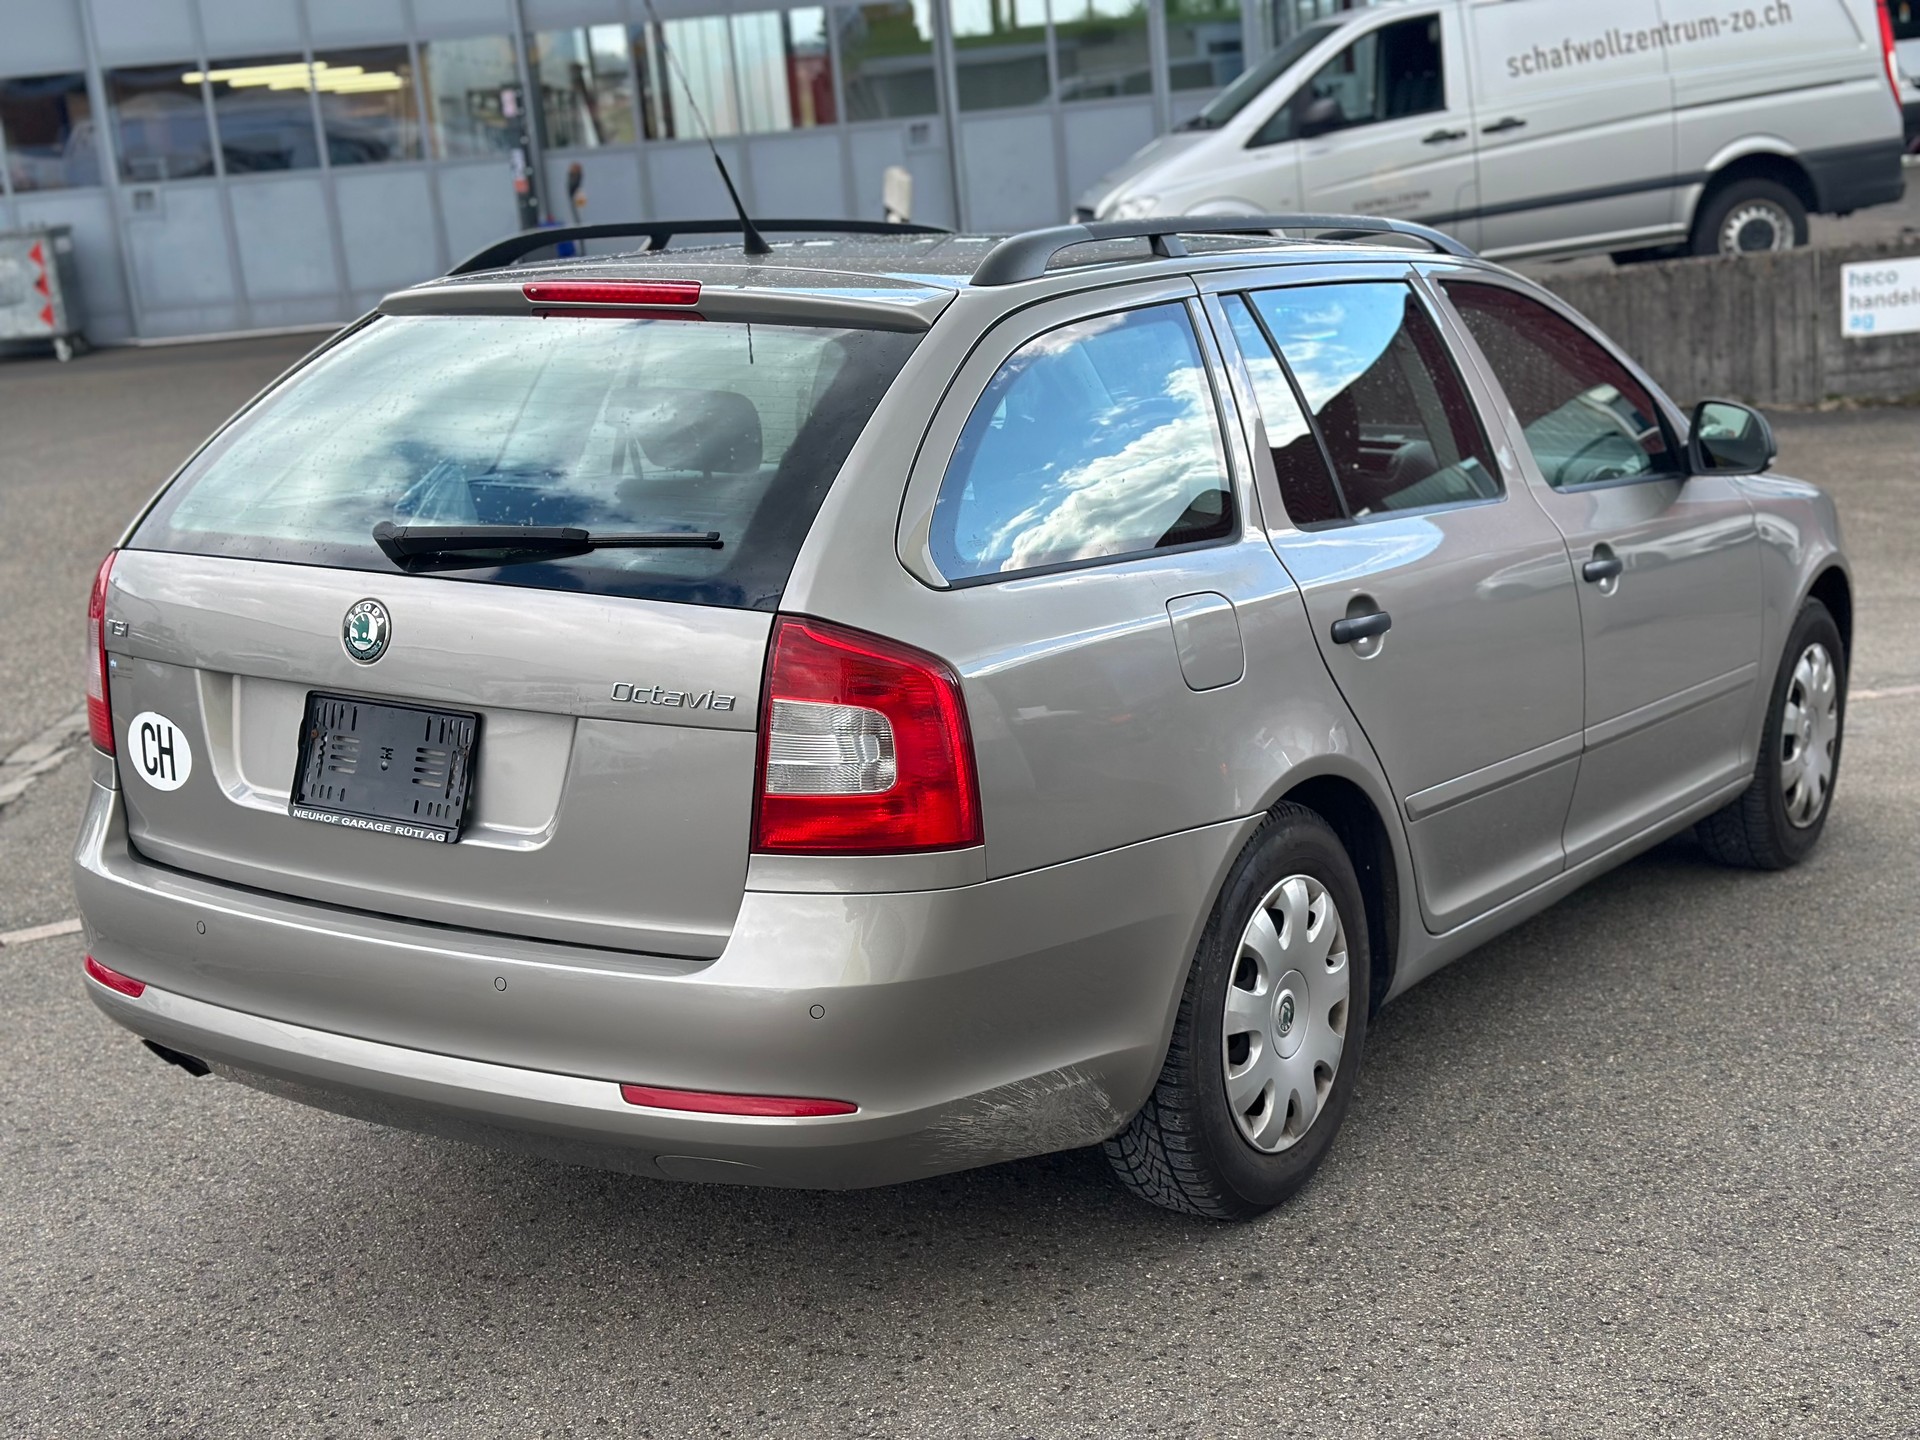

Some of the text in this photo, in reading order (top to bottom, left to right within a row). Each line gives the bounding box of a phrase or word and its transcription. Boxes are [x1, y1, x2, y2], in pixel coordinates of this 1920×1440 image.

[1506, 0, 1793, 78] schafwollzentrum-zo.ch
[1848, 270, 1899, 288] heco
[1848, 313, 1875, 333] ag
[107, 618, 130, 638] TSI
[610, 681, 736, 711] Octavia
[141, 721, 176, 781] CH
[293, 809, 446, 843] NEUHOF GARAGE RÜTI AG
